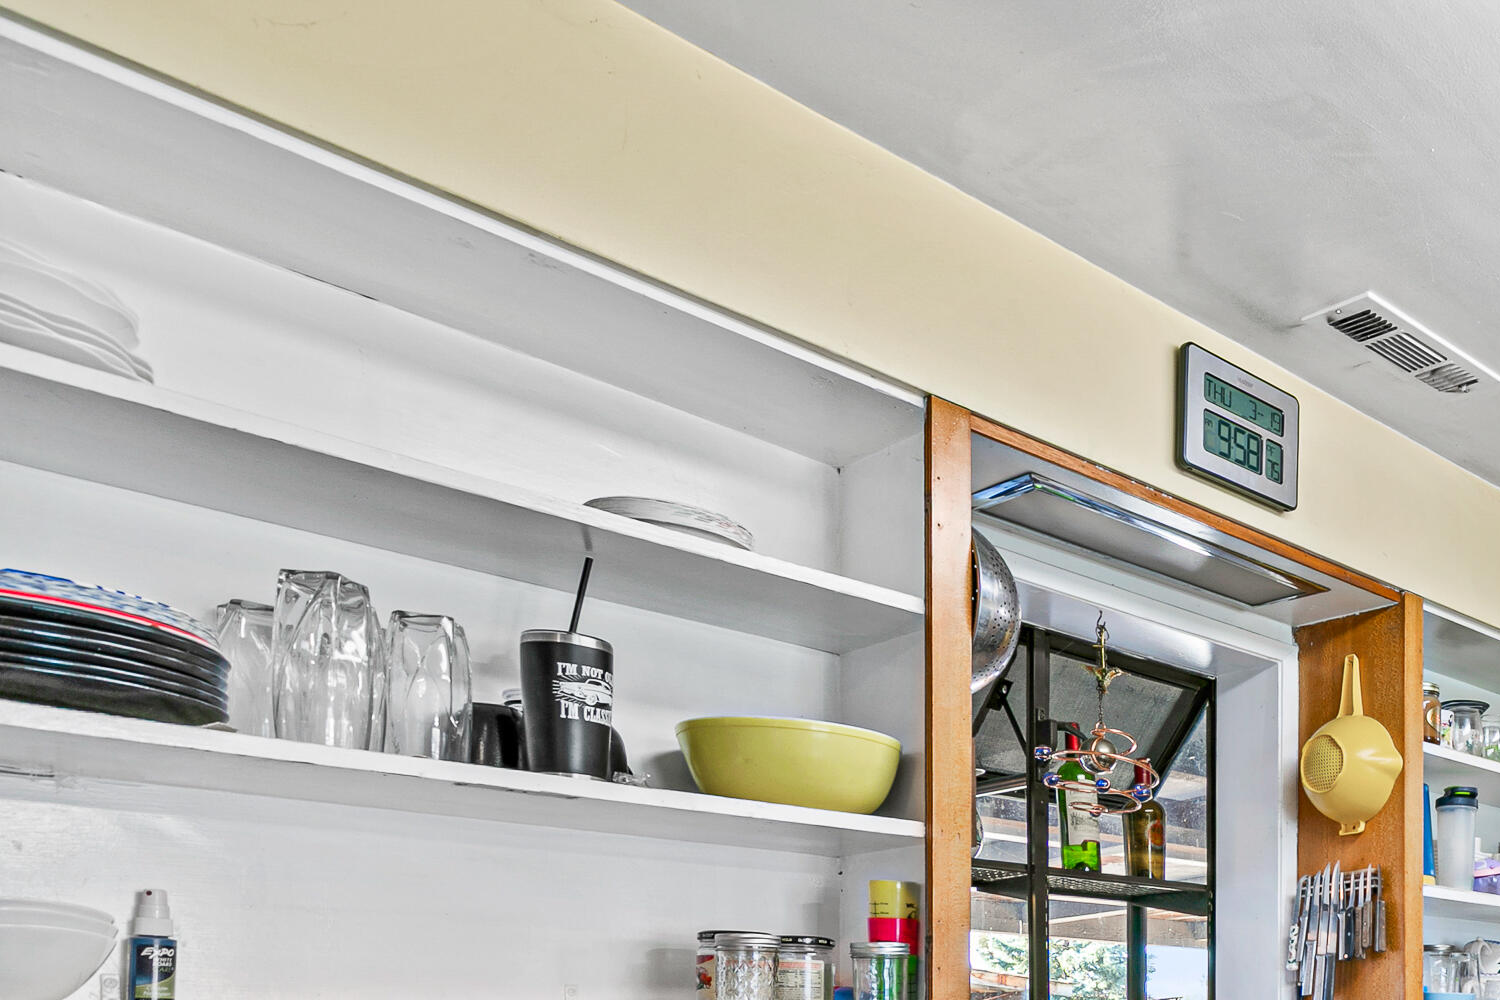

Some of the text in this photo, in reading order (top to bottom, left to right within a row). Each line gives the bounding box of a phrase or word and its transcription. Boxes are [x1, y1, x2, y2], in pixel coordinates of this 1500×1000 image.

[1206, 378, 1232, 408] THU
[1217, 419, 1260, 472] 9:58
[1266, 458, 1280, 482] 75
[557, 662, 578, 676] I'M
[581, 665, 604, 679] NOT
[560, 700, 579, 720] I'M
[141, 947, 174, 959] EXPO
